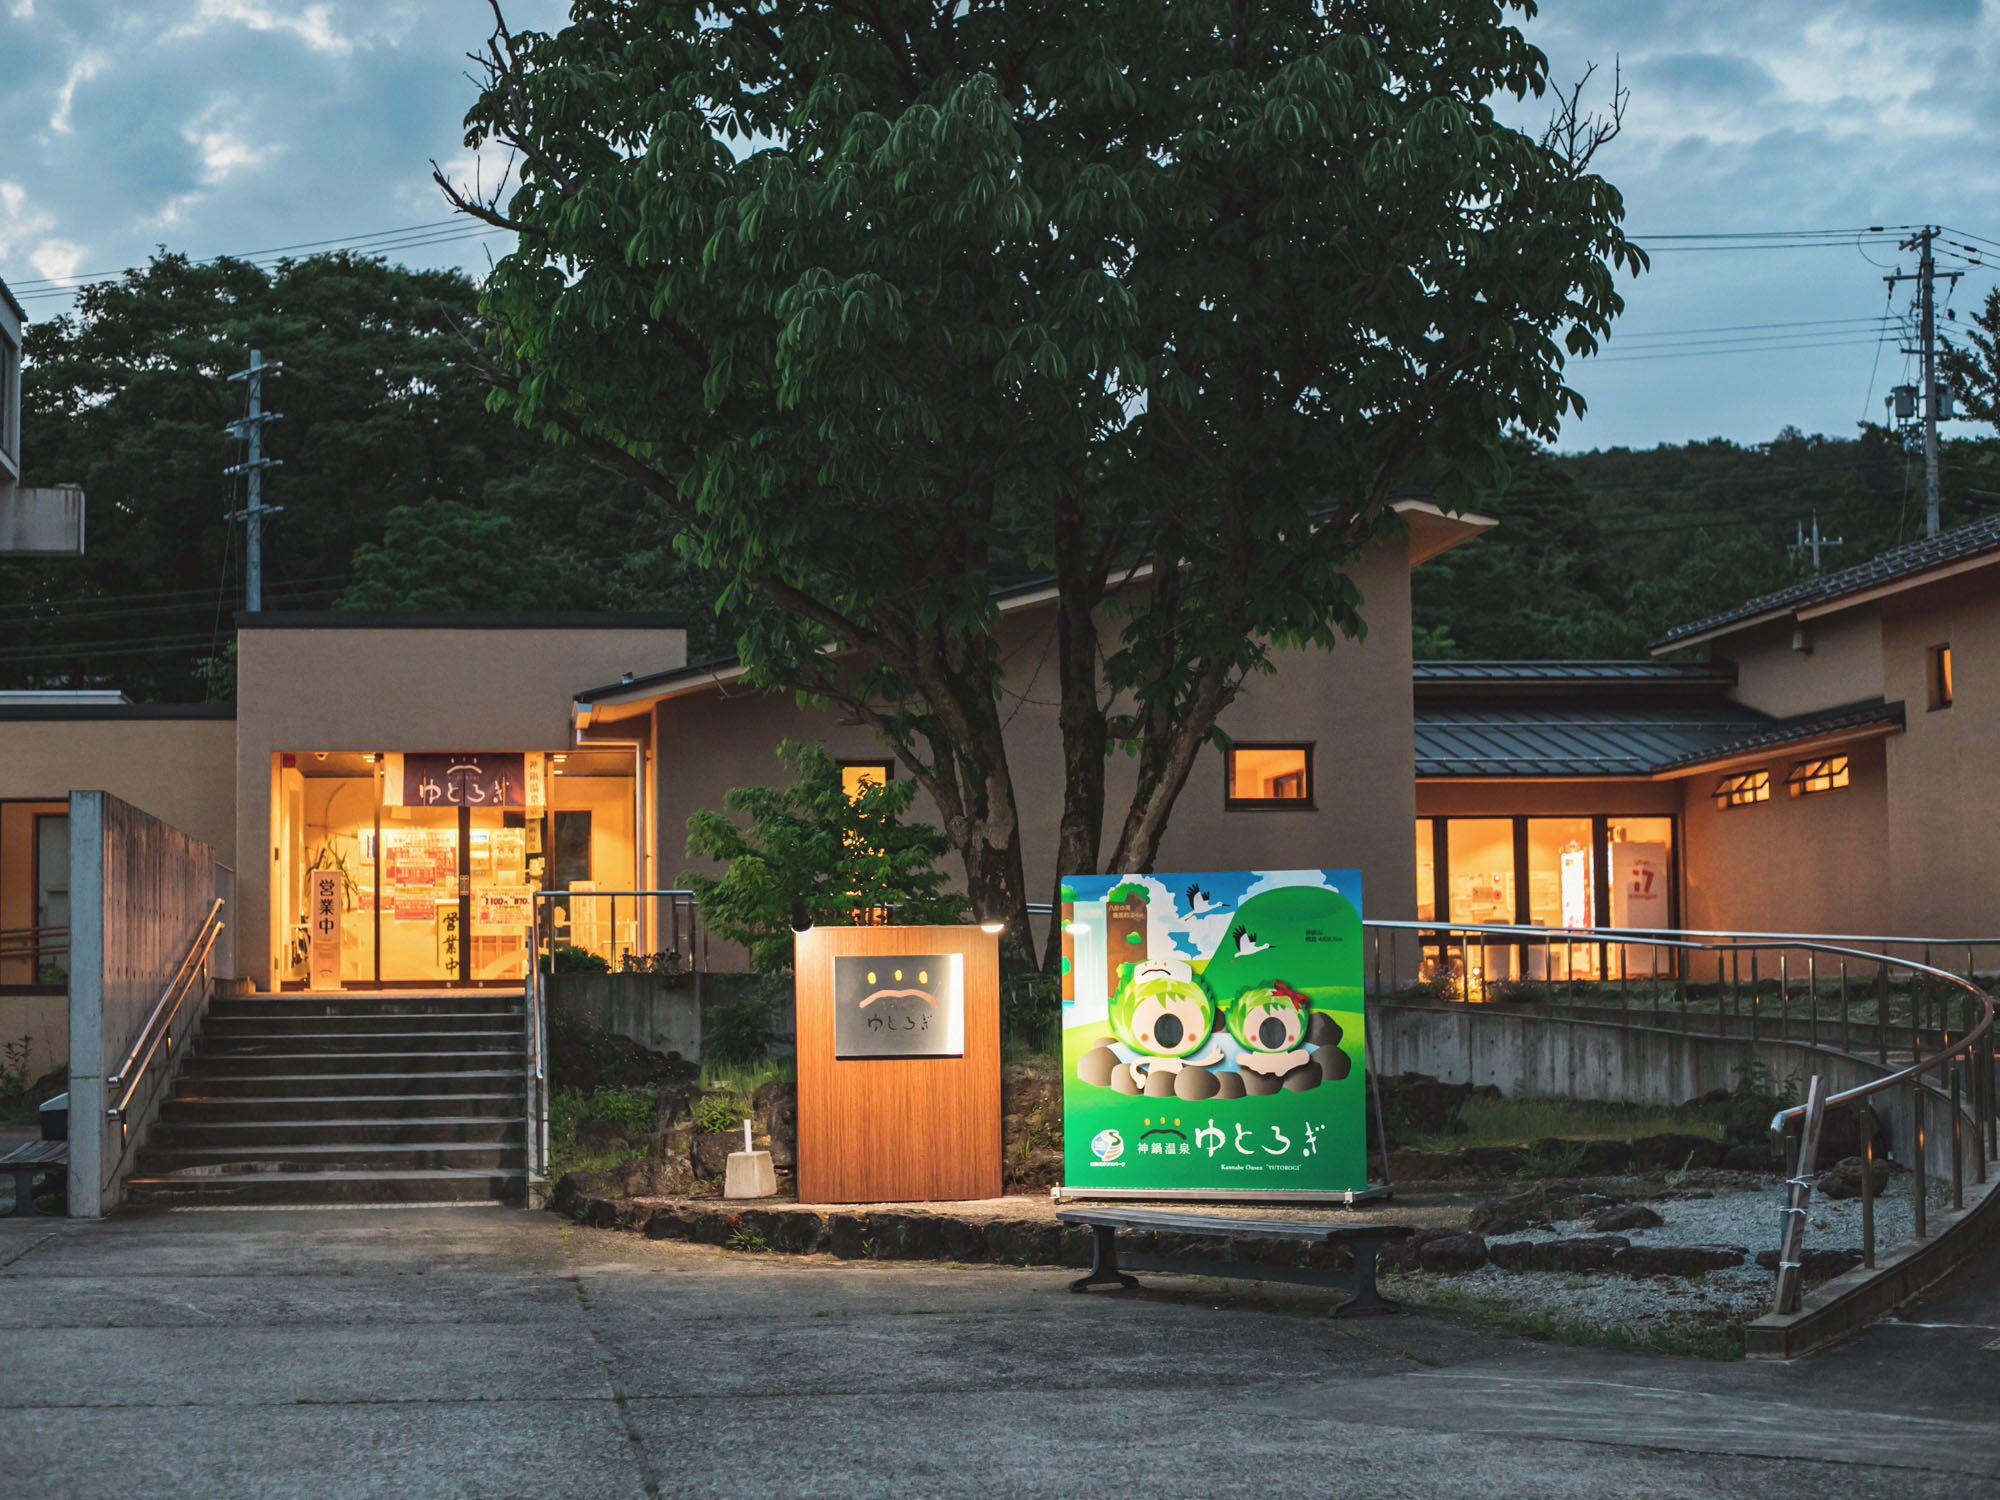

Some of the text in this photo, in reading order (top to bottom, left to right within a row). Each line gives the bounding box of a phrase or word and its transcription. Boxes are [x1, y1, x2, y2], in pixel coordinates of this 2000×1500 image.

[419, 778, 510, 804] ゆとろぎ
[319, 879, 335, 935] 営業中
[443, 911, 460, 977] 営業中
[867, 1013, 933, 1032] ゆとろぎ
[1137, 1142, 1191, 1155] 神鍋温泉
[1194, 1118, 1326, 1158] ゆとろぎ
